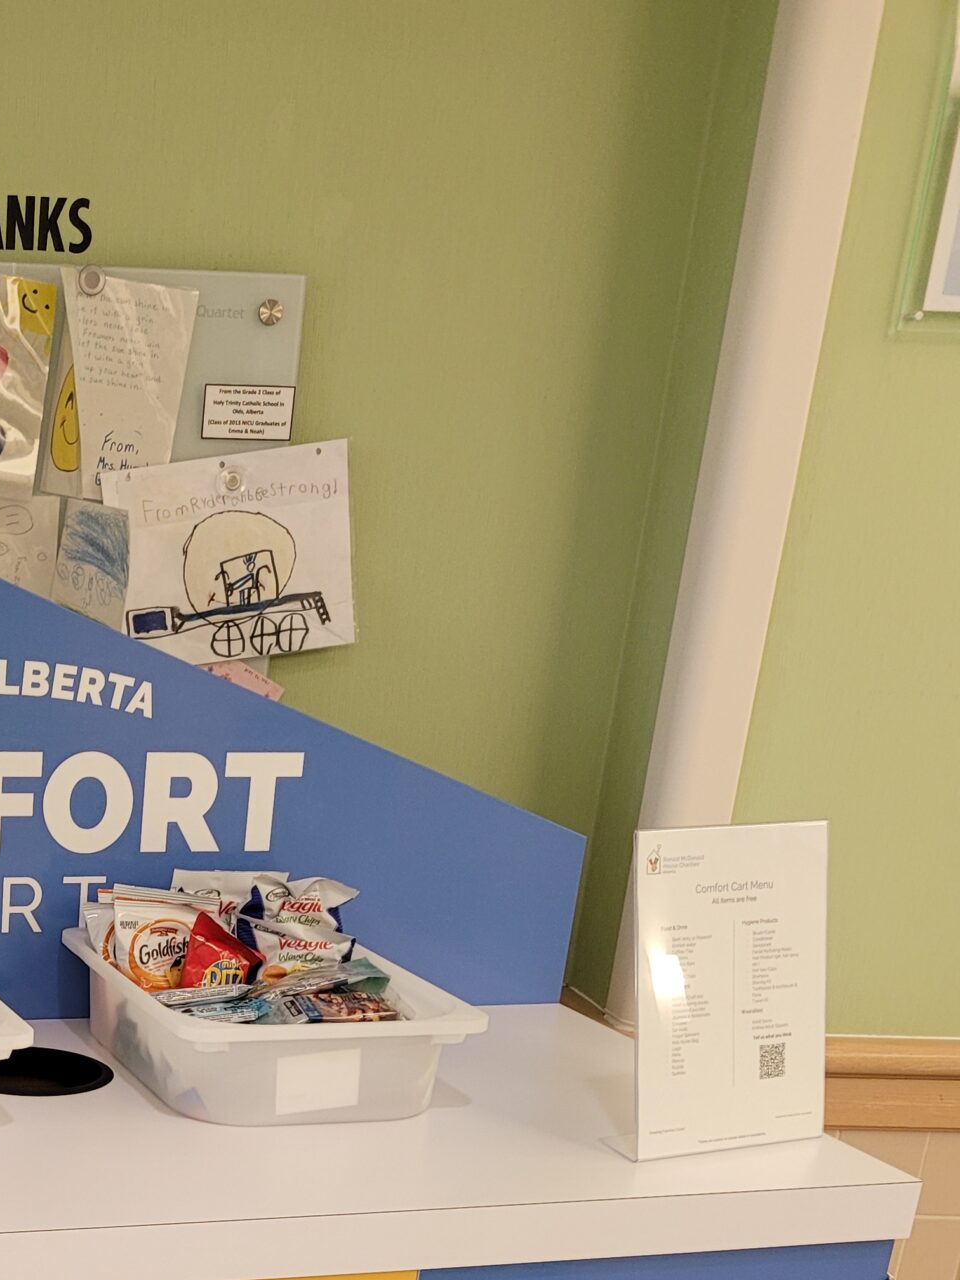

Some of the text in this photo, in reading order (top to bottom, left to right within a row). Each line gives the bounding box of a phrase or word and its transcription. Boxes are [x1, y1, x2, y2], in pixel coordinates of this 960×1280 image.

[196, 304, 246, 320] Quartet
[695, 880, 774, 894] Comfort Cart Menu
